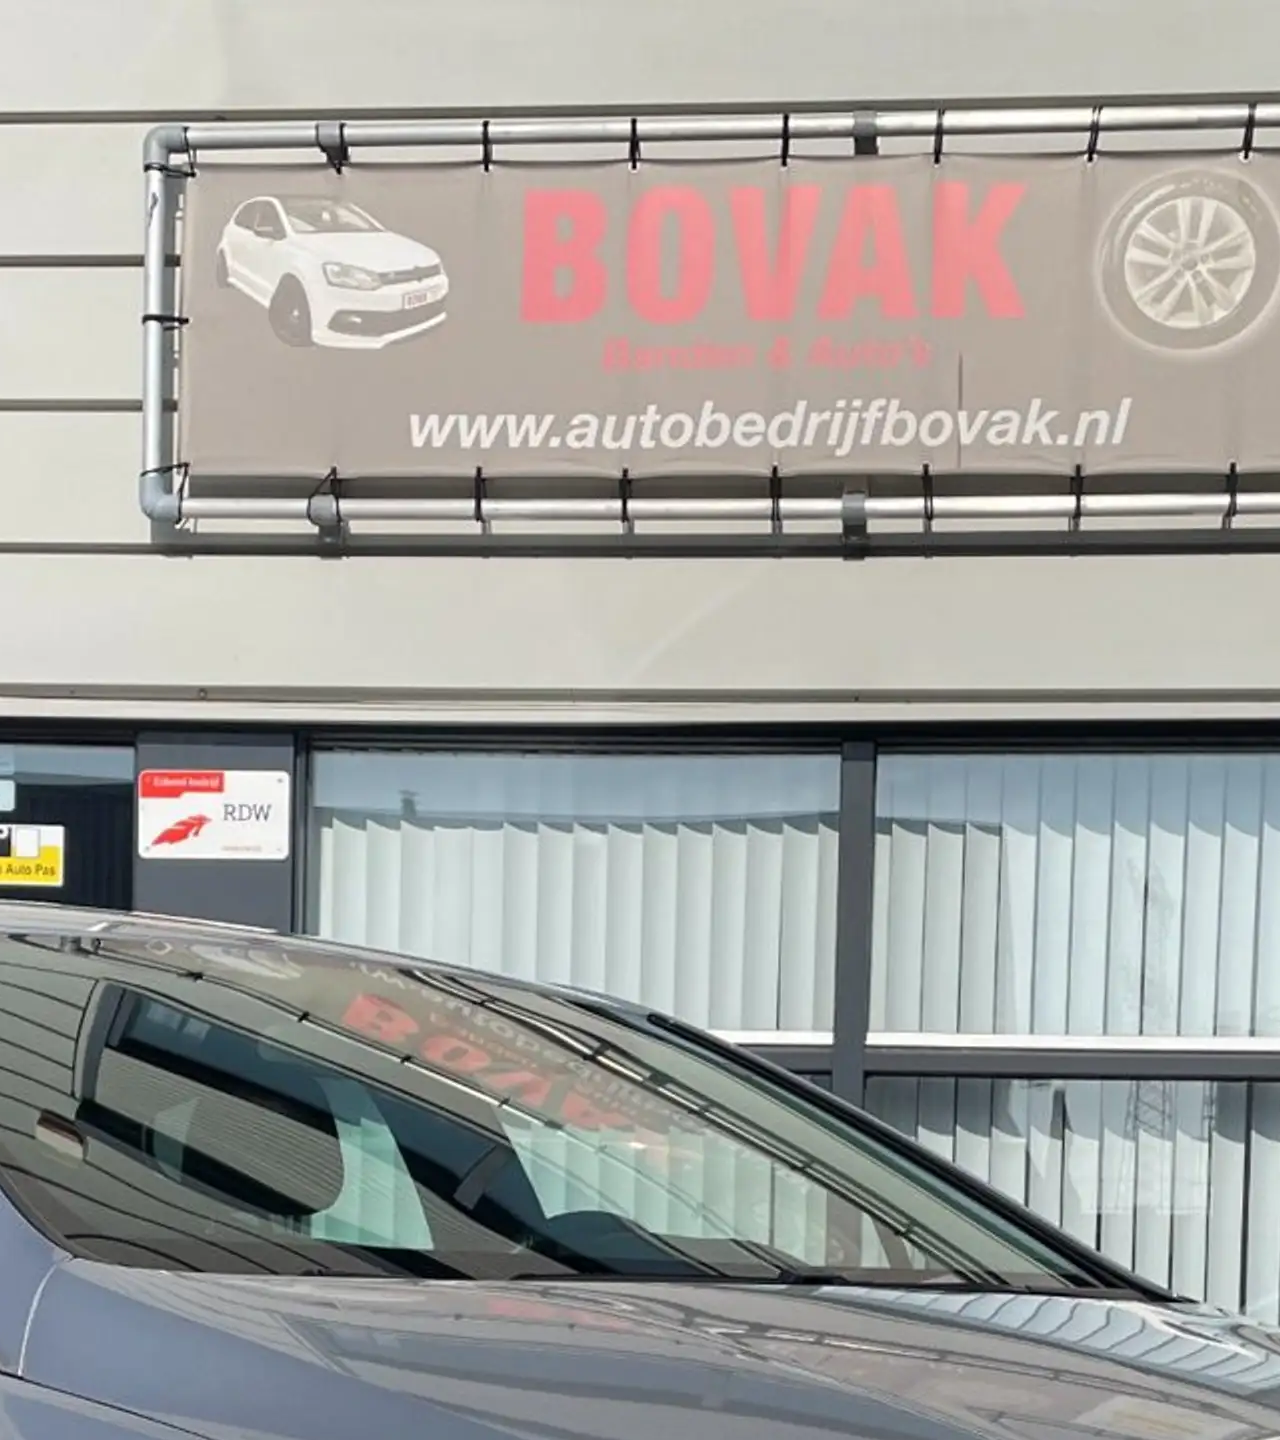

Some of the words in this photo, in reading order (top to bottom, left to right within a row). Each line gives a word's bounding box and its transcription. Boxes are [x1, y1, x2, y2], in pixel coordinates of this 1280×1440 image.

[522, 181, 1027, 324] BOVAK
[409, 397, 1133, 457] www.autobedrijfbovak.nl
[223, 804, 271, 821] RDW
[6, 863, 31, 876] Auto
[35, 865, 56, 877] Pas
